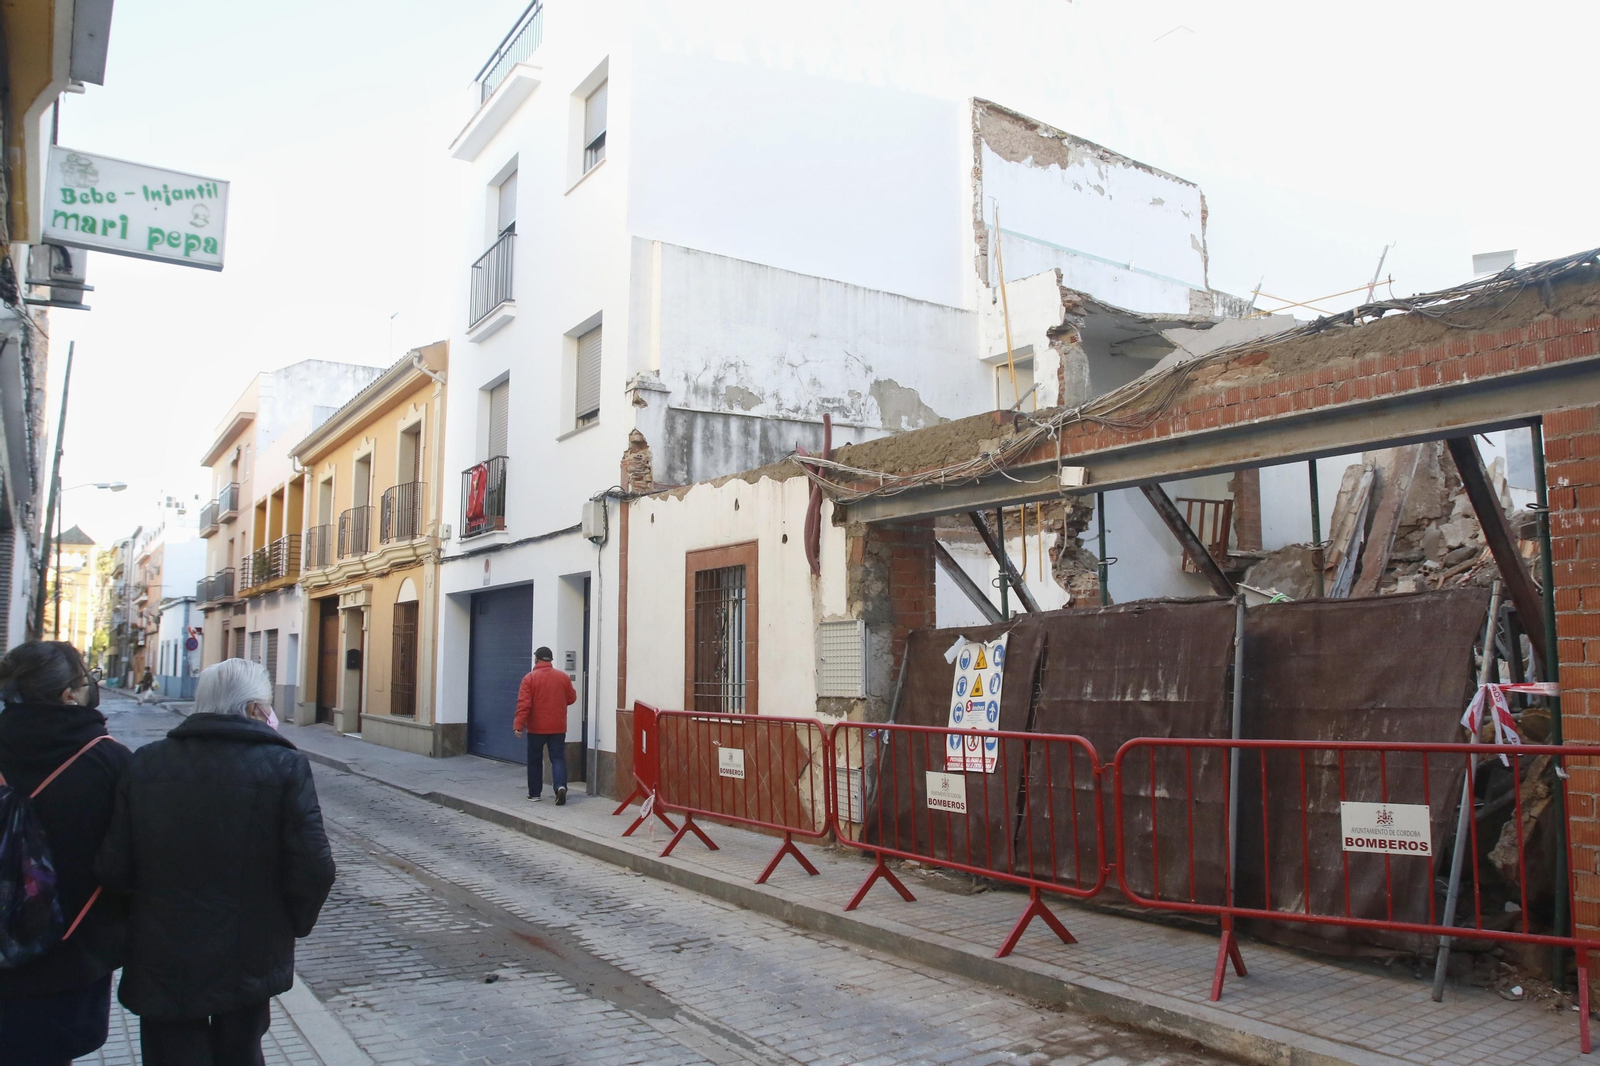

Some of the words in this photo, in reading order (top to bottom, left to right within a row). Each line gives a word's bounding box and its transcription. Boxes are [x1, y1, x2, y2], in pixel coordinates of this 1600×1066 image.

[60, 186, 117, 205] Bebe
[51, 208, 129, 240] mari
[146, 225, 218, 257] pepa
[928, 797, 966, 810] BOMBEROS
[1351, 827, 1389, 836] AYUNTAMIENTO
[1396, 829, 1421, 837] CORDOBA
[1344, 836, 1429, 852] BOMBEROS
